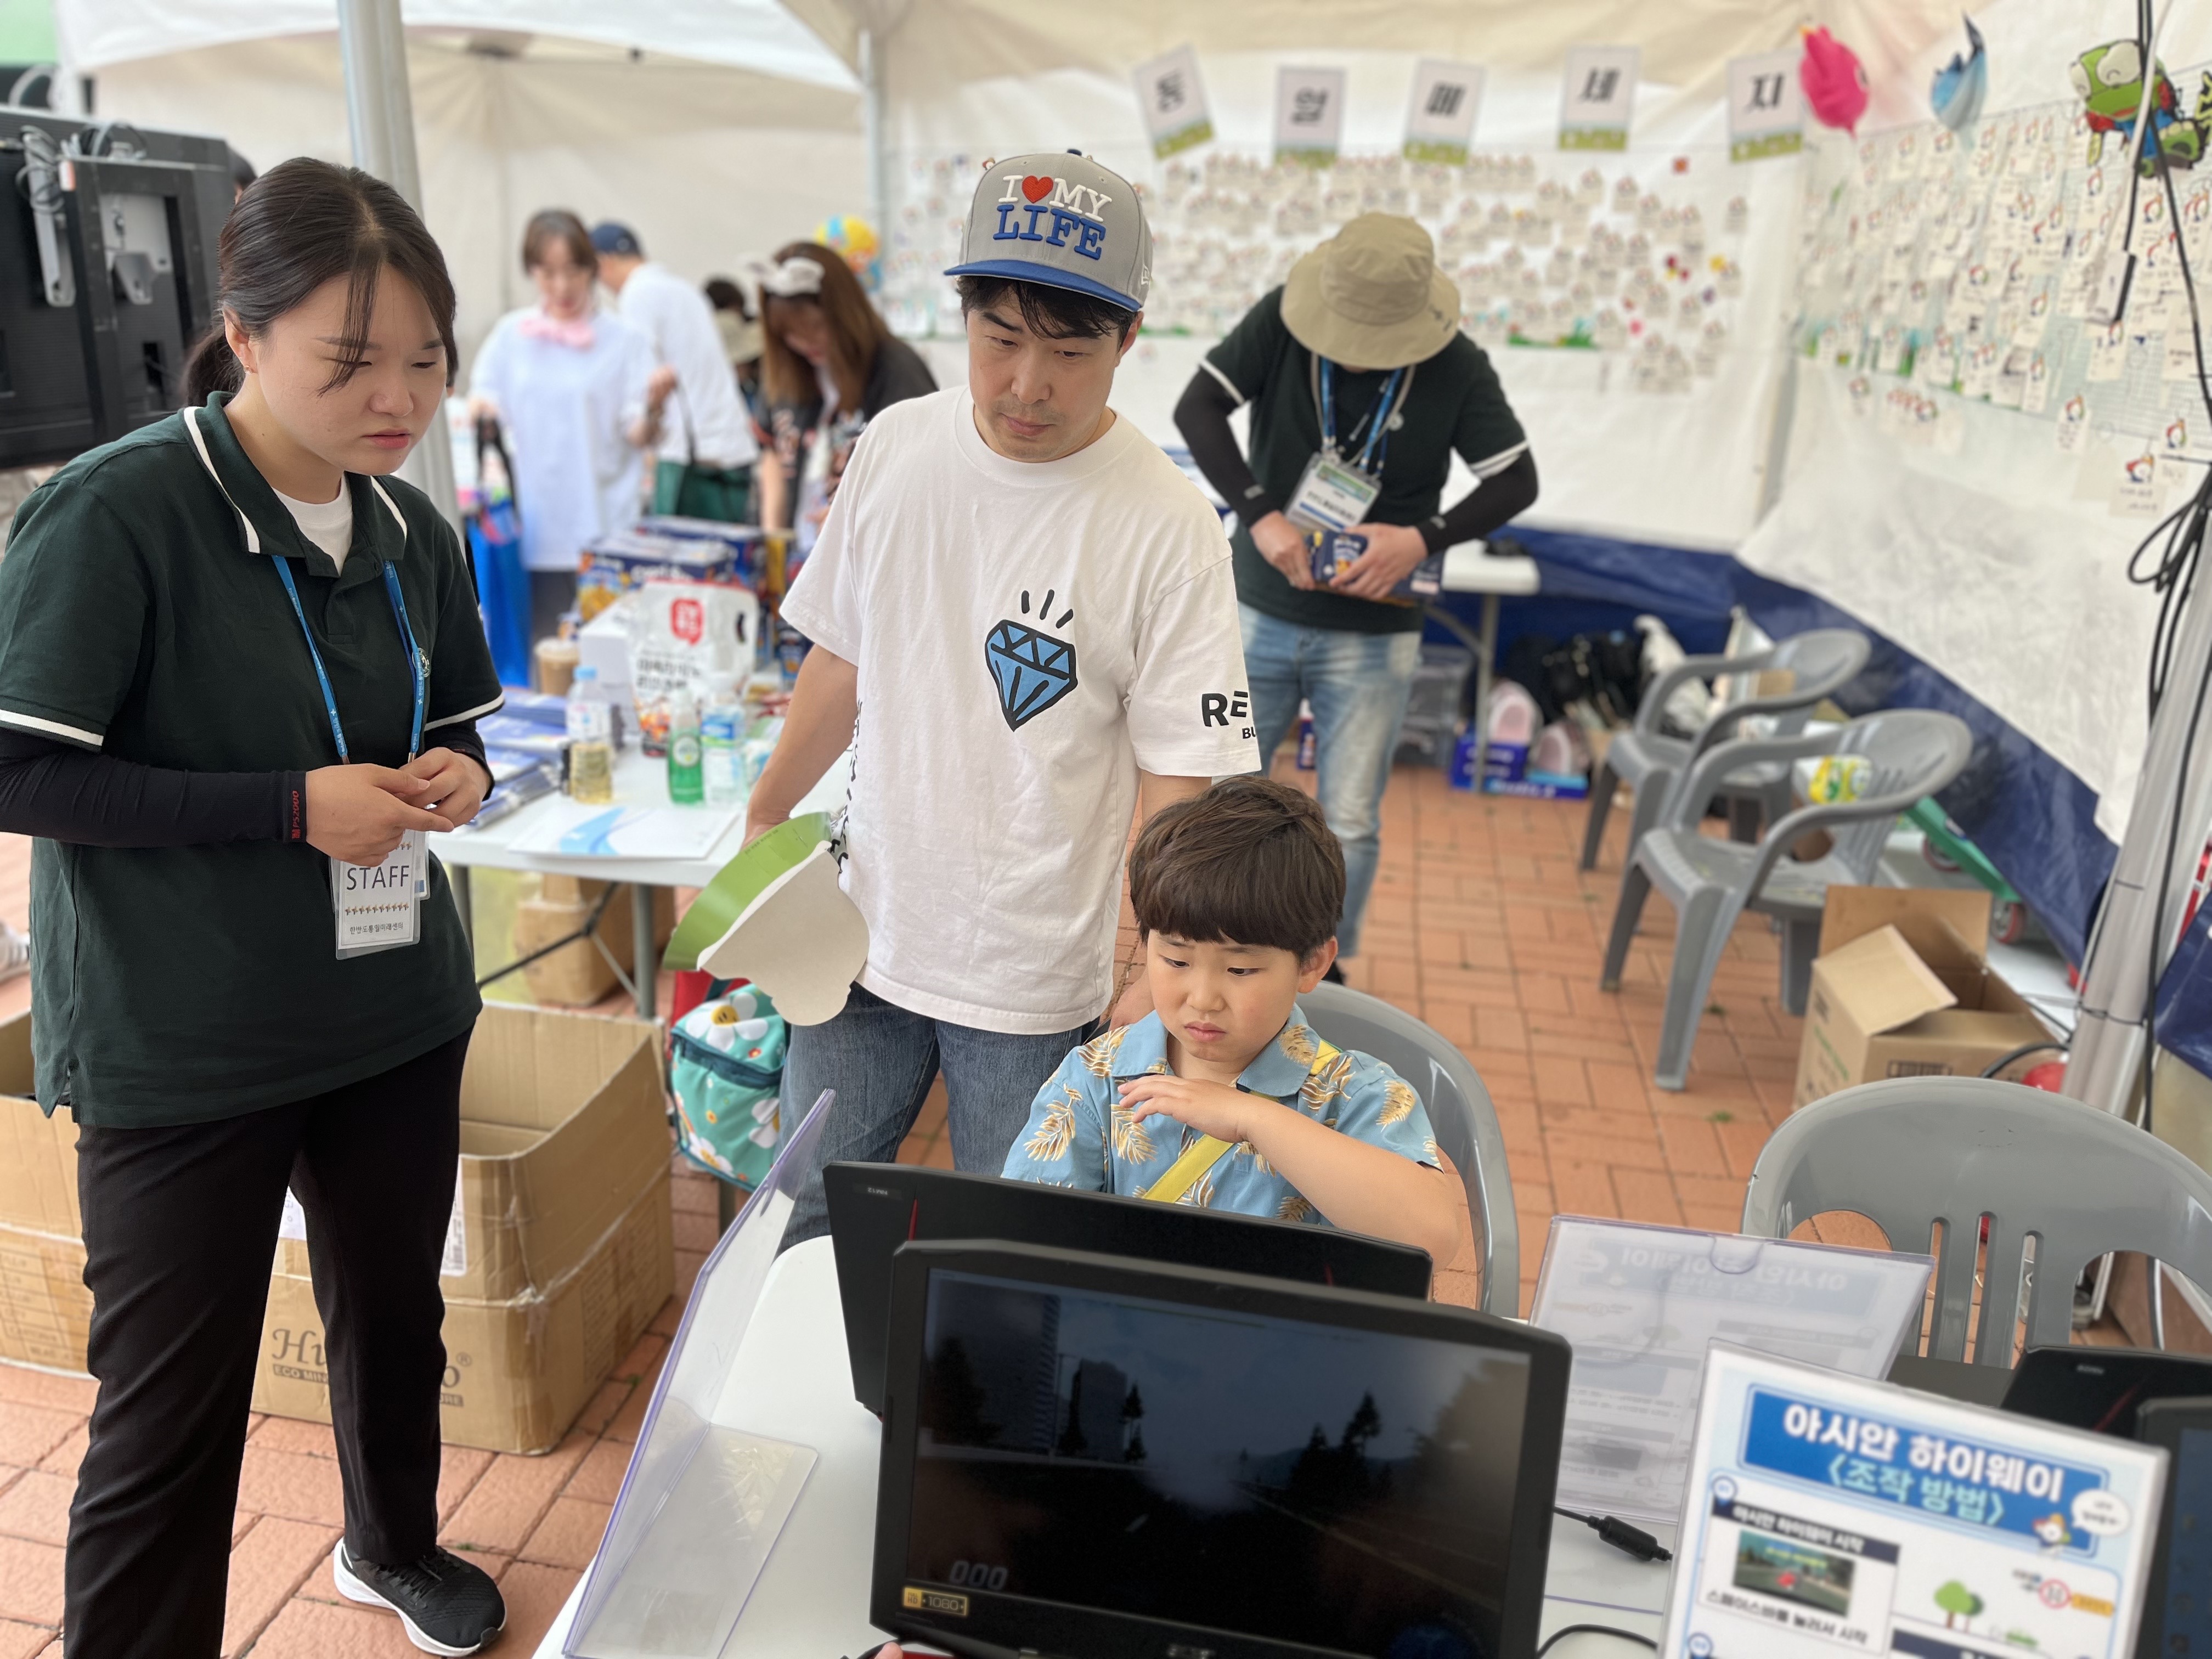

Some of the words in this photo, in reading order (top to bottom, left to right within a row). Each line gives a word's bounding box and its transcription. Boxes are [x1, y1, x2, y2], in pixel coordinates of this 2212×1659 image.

[998, 175, 1023, 202] I
[1049, 178, 1112, 222] MY
[993, 204, 1106, 260] LIFE
[347, 865, 410, 890] STAFF
[274, 1367, 300, 1378] ECO
[1784, 1403, 1899, 1462] 아시안
[1909, 1435, 2064, 1503] 하이웨이
[950, 1561, 1008, 1589] 000
[929, 1596, 958, 1610] 1080
